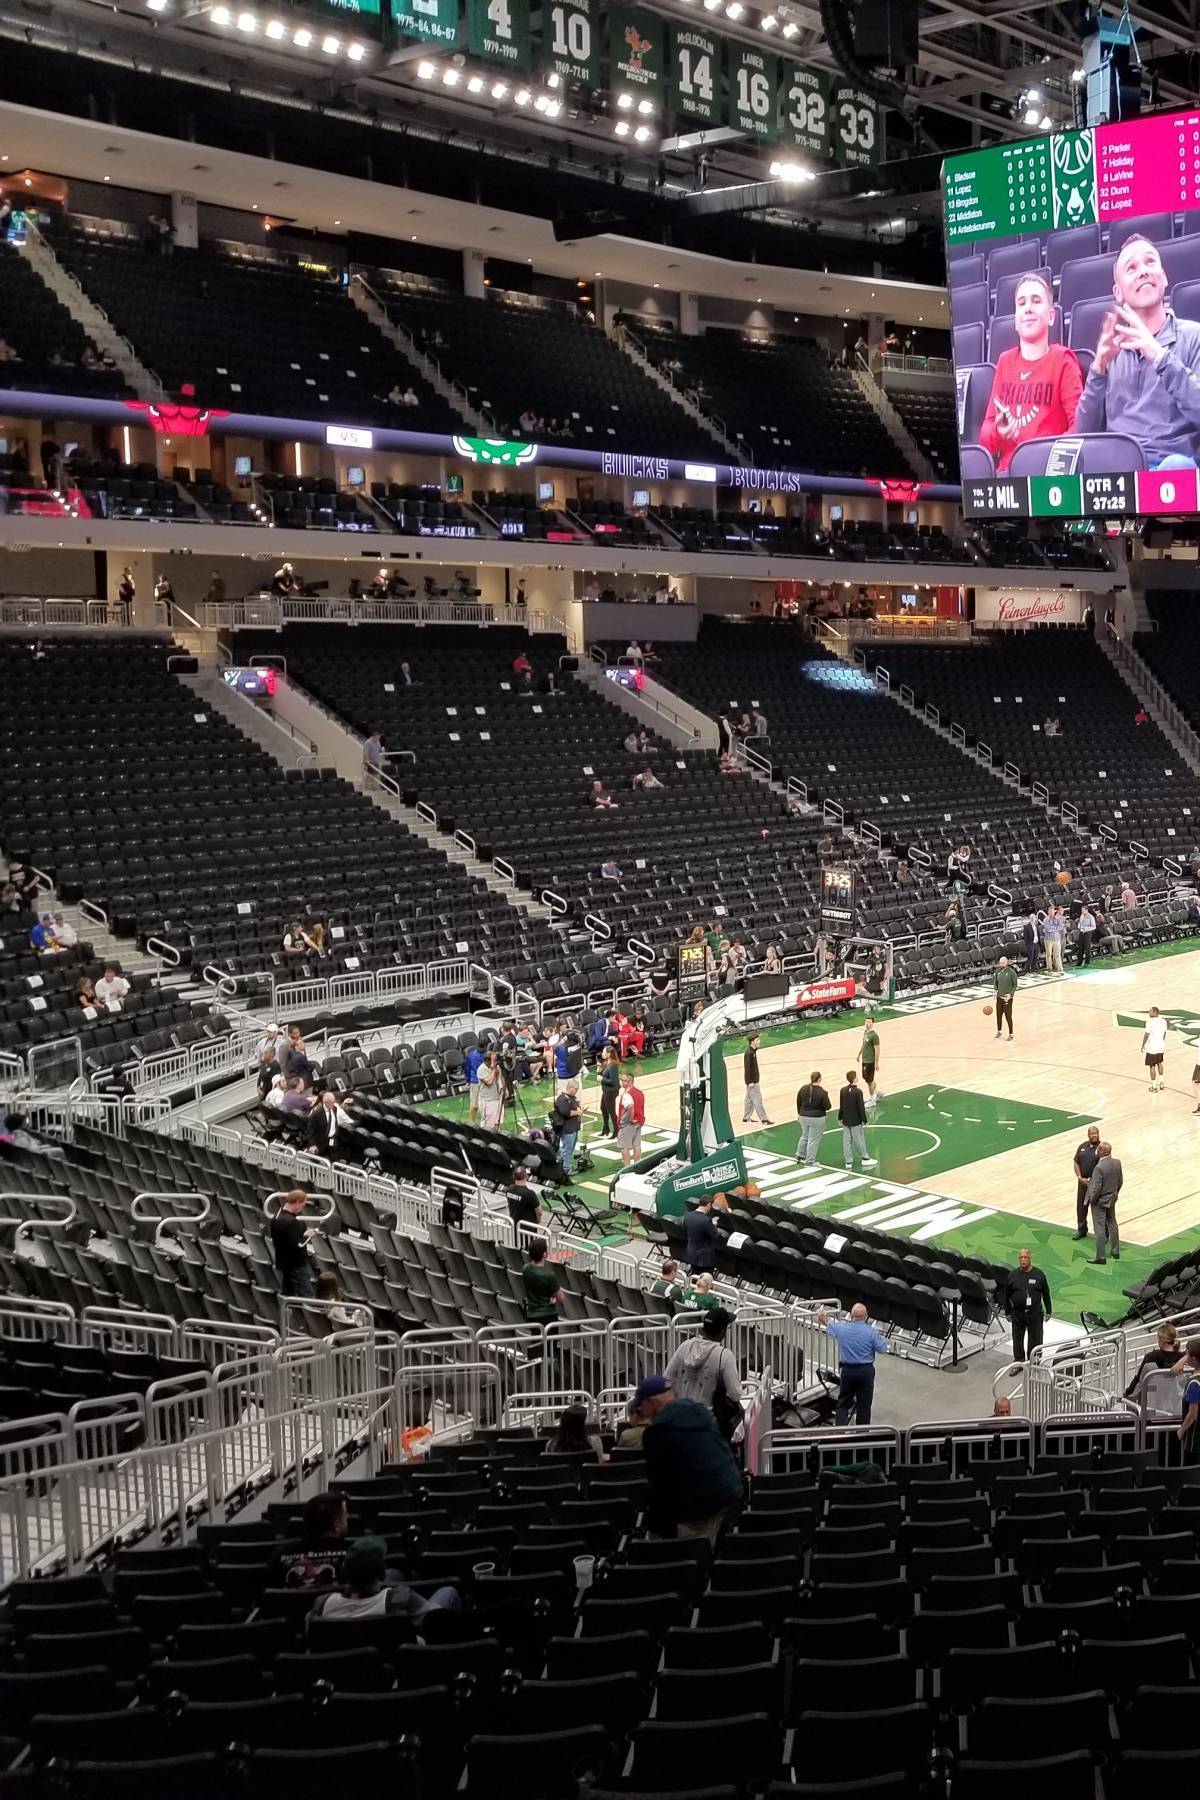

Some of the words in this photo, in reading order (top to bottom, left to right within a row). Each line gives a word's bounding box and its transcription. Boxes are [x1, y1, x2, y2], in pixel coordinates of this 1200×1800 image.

[488, 0, 512, 39] 4
[551, 7, 591, 61] 10
[742, 53, 763, 69] LANIER
[626, 71, 648, 84] BUCKS
[678, 49, 713, 100] 14
[794, 71, 819, 88] WINTERS
[737, 68, 770, 116] 16
[788, 87, 825, 135] 32
[839, 103, 874, 149] 33
[1102, 146, 1107, 155] 2
[1108, 144, 1131, 154] Parker
[1179, 133, 1184, 143] 0
[1193, 131, 1199, 141] 0
[1008, 162, 1013, 171] 0
[1018, 160, 1023, 169] 0
[1029, 158, 1034, 167] 0
[1040, 156, 1045, 165] 0
[1103, 159, 1107, 168] 7
[1109, 156, 1134, 168] Holiday
[1179, 147, 1185, 157] 0
[1194, 145, 1199, 155] 0
[1110, 171, 1134, 181] LaVine
[1180, 162, 1185, 171] 0
[1194, 160, 1200, 169] 0
[947, 187, 953, 196] 11
[955, 185, 971, 195] Lopez
[1008, 175, 1013, 184] 0
[1019, 173, 1024, 182] 0
[1030, 171, 1035, 180] 0
[1040, 169, 1045, 178] 0
[1100, 188, 1109, 197] 32
[1110, 186, 1129, 196] Dunn
[948, 200, 955, 209] 13
[956, 197, 978, 208] Brogdon
[1100, 201, 1109, 210] 42
[1111, 199, 1132, 210] Lopez
[948, 214, 956, 222] 22
[949, 227, 957, 236] 34
[340, 432, 358, 442] VS
[602, 452, 669, 480] BUCKS
[729, 466, 800, 492] BULLS
[973, 488, 984, 496] TOL
[987, 487, 993, 496] 7
[1086, 478, 1112, 494] QTR
[1117, 477, 1125, 492] 1
[1160, 482, 1175, 503] 0
[988, 499, 994, 508] 0
[996, 486, 1019, 509] MIL
[1048, 487, 1062, 507] 0
[1093, 496, 1125, 510] 37:25
[999, 593, 1066, 621] Leinenkugel's
[675, 1176, 703, 1189] Froedtert
